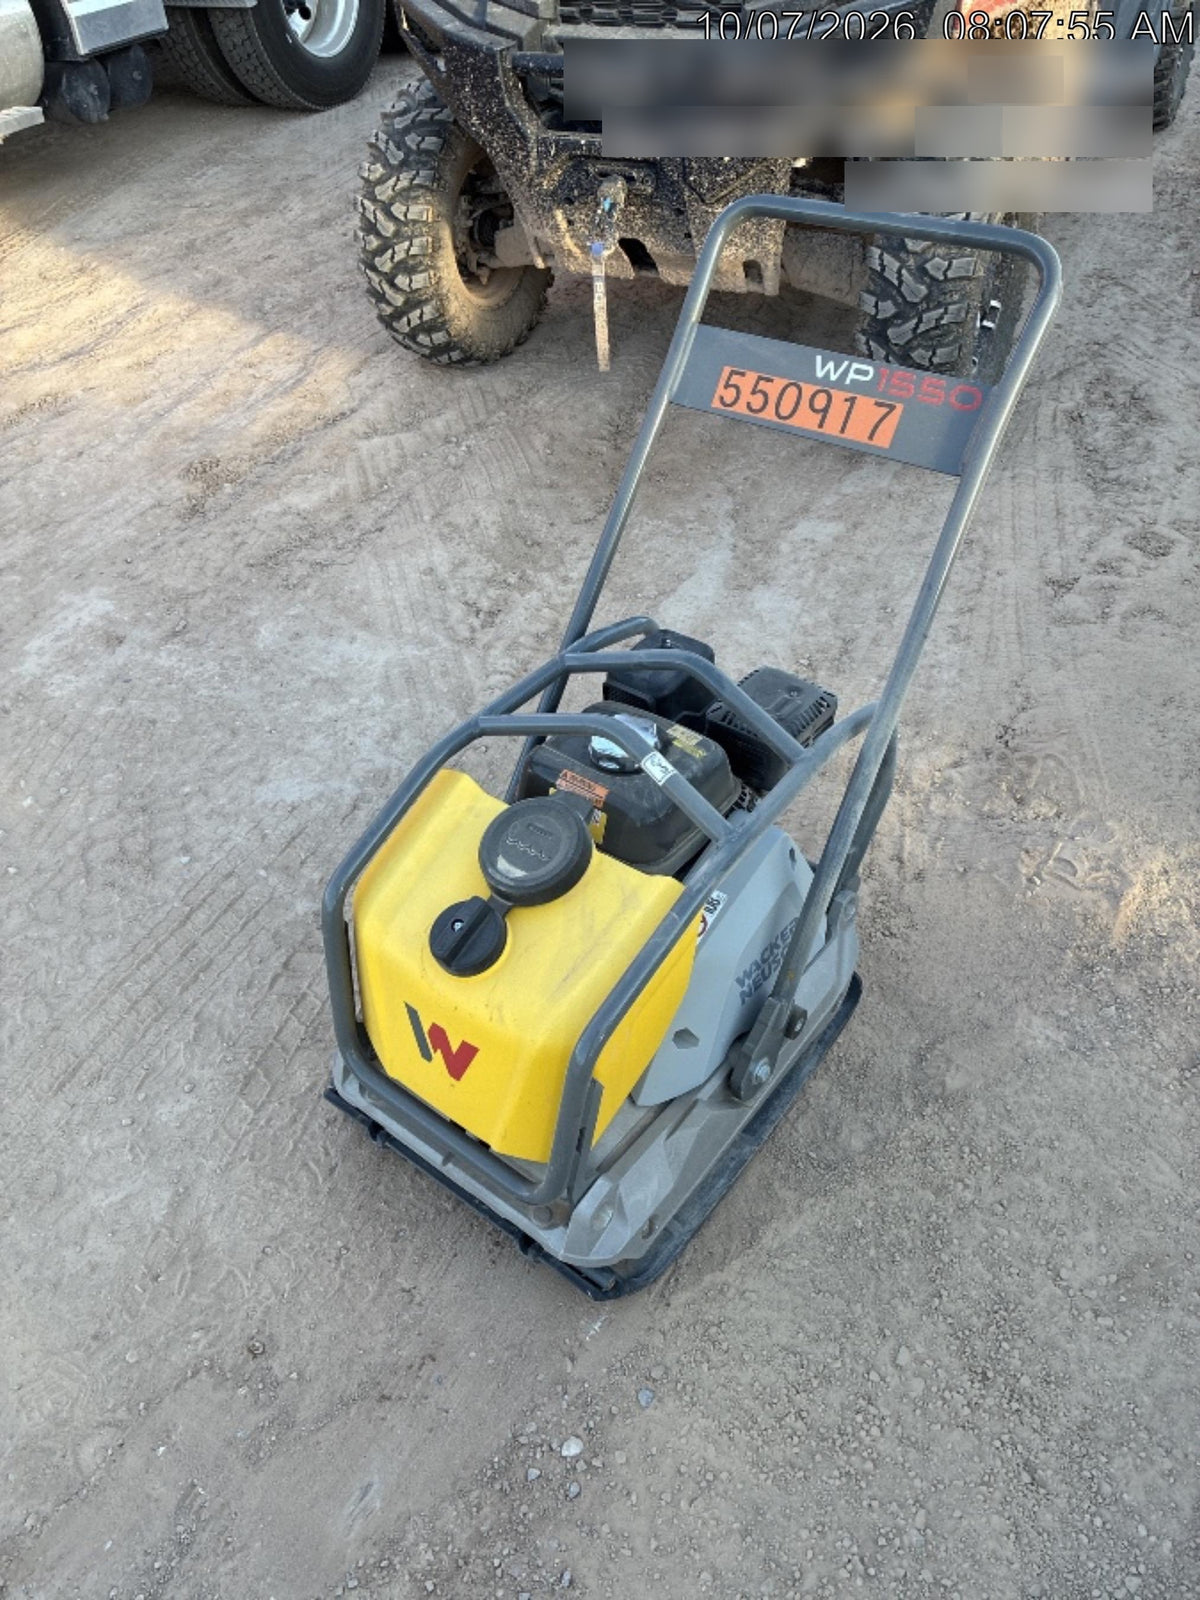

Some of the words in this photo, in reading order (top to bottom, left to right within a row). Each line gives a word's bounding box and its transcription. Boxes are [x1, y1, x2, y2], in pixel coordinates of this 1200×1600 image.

[719, 369, 897, 441] 550917
[815, 355, 983, 412] WP1550
[739, 945, 789, 1006] NEUS
